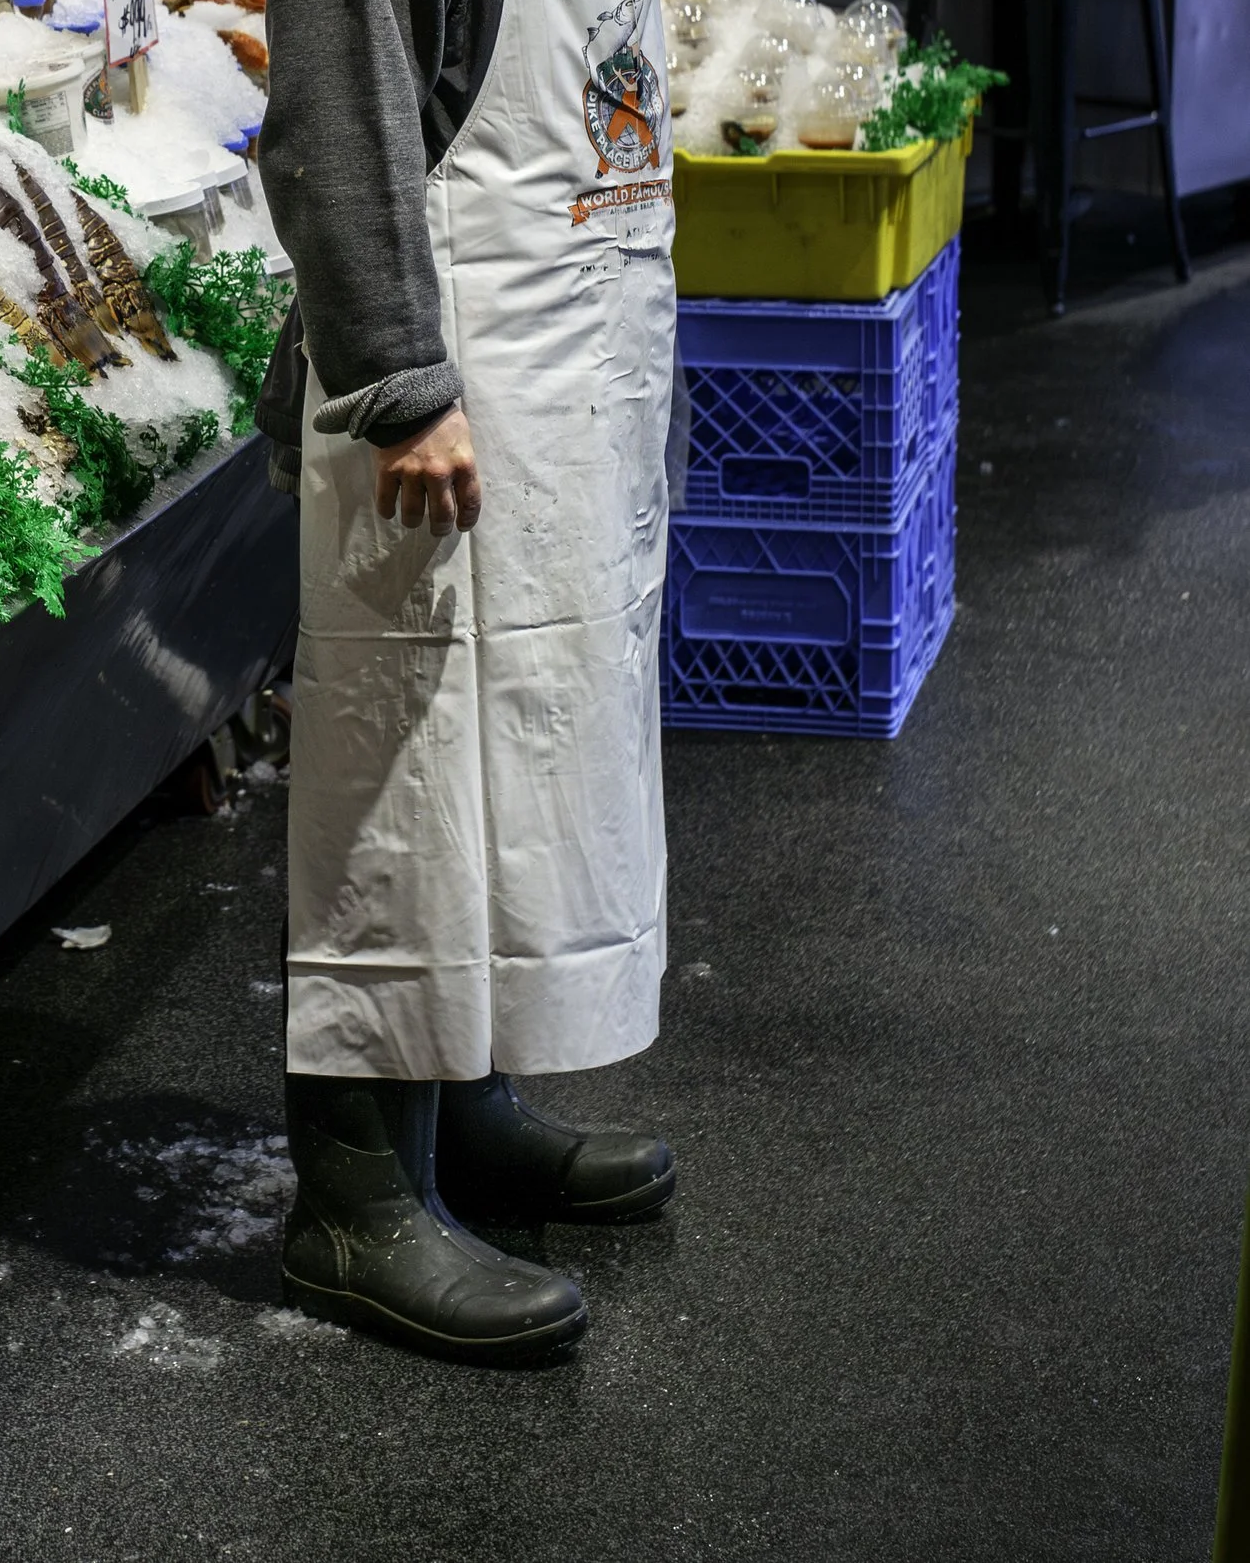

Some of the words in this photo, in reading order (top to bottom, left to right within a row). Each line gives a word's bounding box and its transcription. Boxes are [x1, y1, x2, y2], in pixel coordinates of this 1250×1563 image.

[587, 90, 600, 133] PIKE
[597, 135, 631, 168] PLACE
[581, 188, 628, 208] WORLD
[630, 183, 670, 200] FAMOUS
